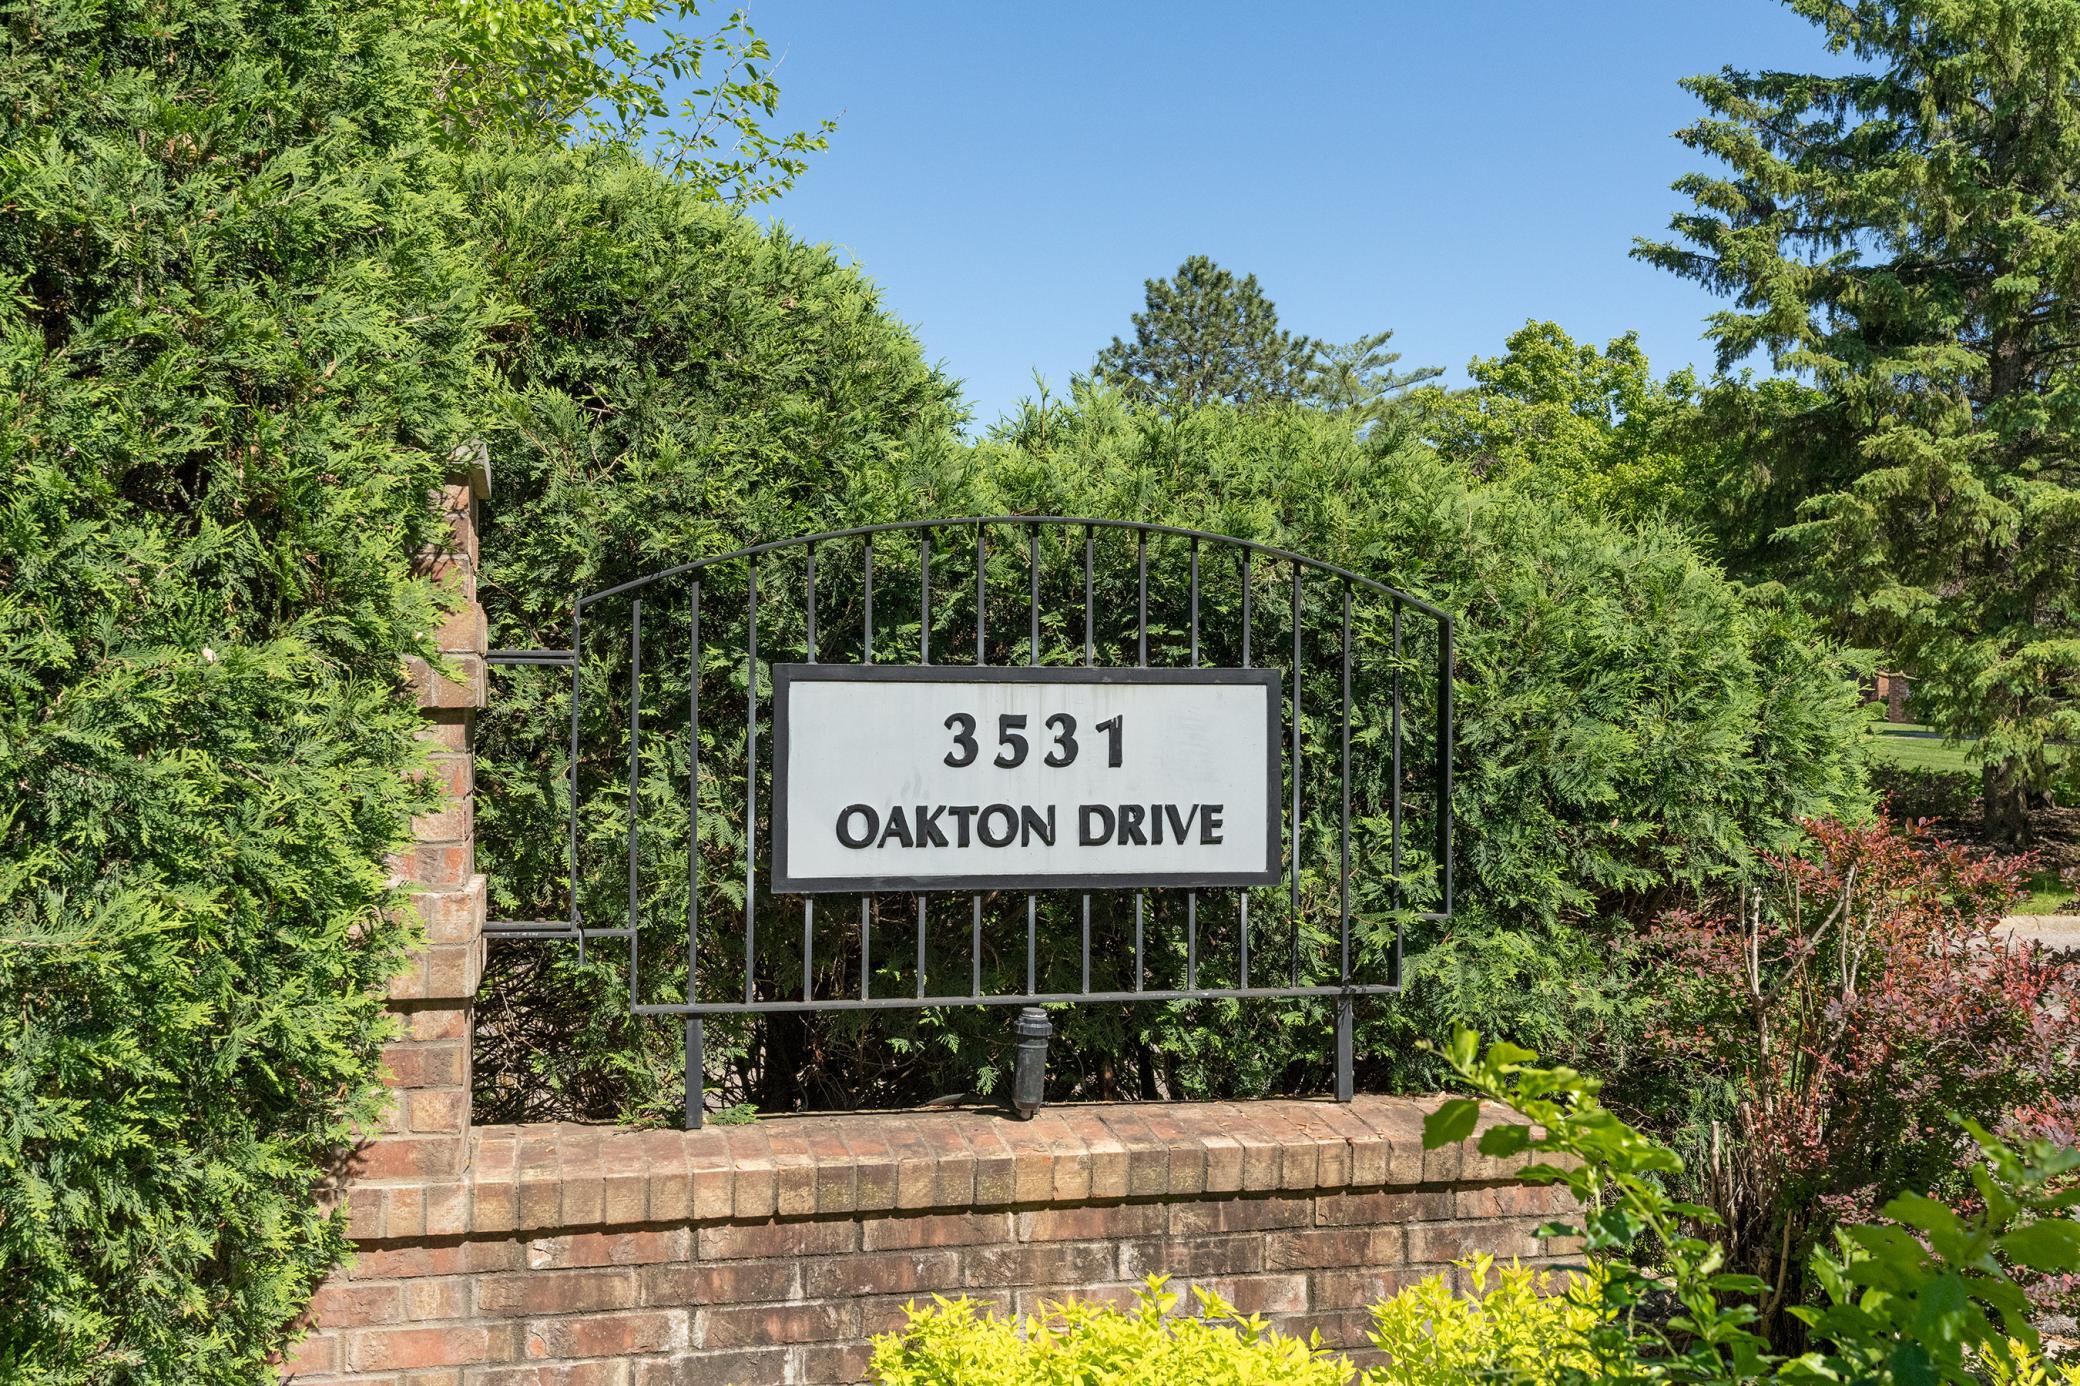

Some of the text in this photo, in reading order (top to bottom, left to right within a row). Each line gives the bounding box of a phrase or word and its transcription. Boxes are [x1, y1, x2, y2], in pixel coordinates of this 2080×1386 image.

[944, 713, 1123, 769] 3531
[835, 804, 1224, 849] OAKTON DRIVE
